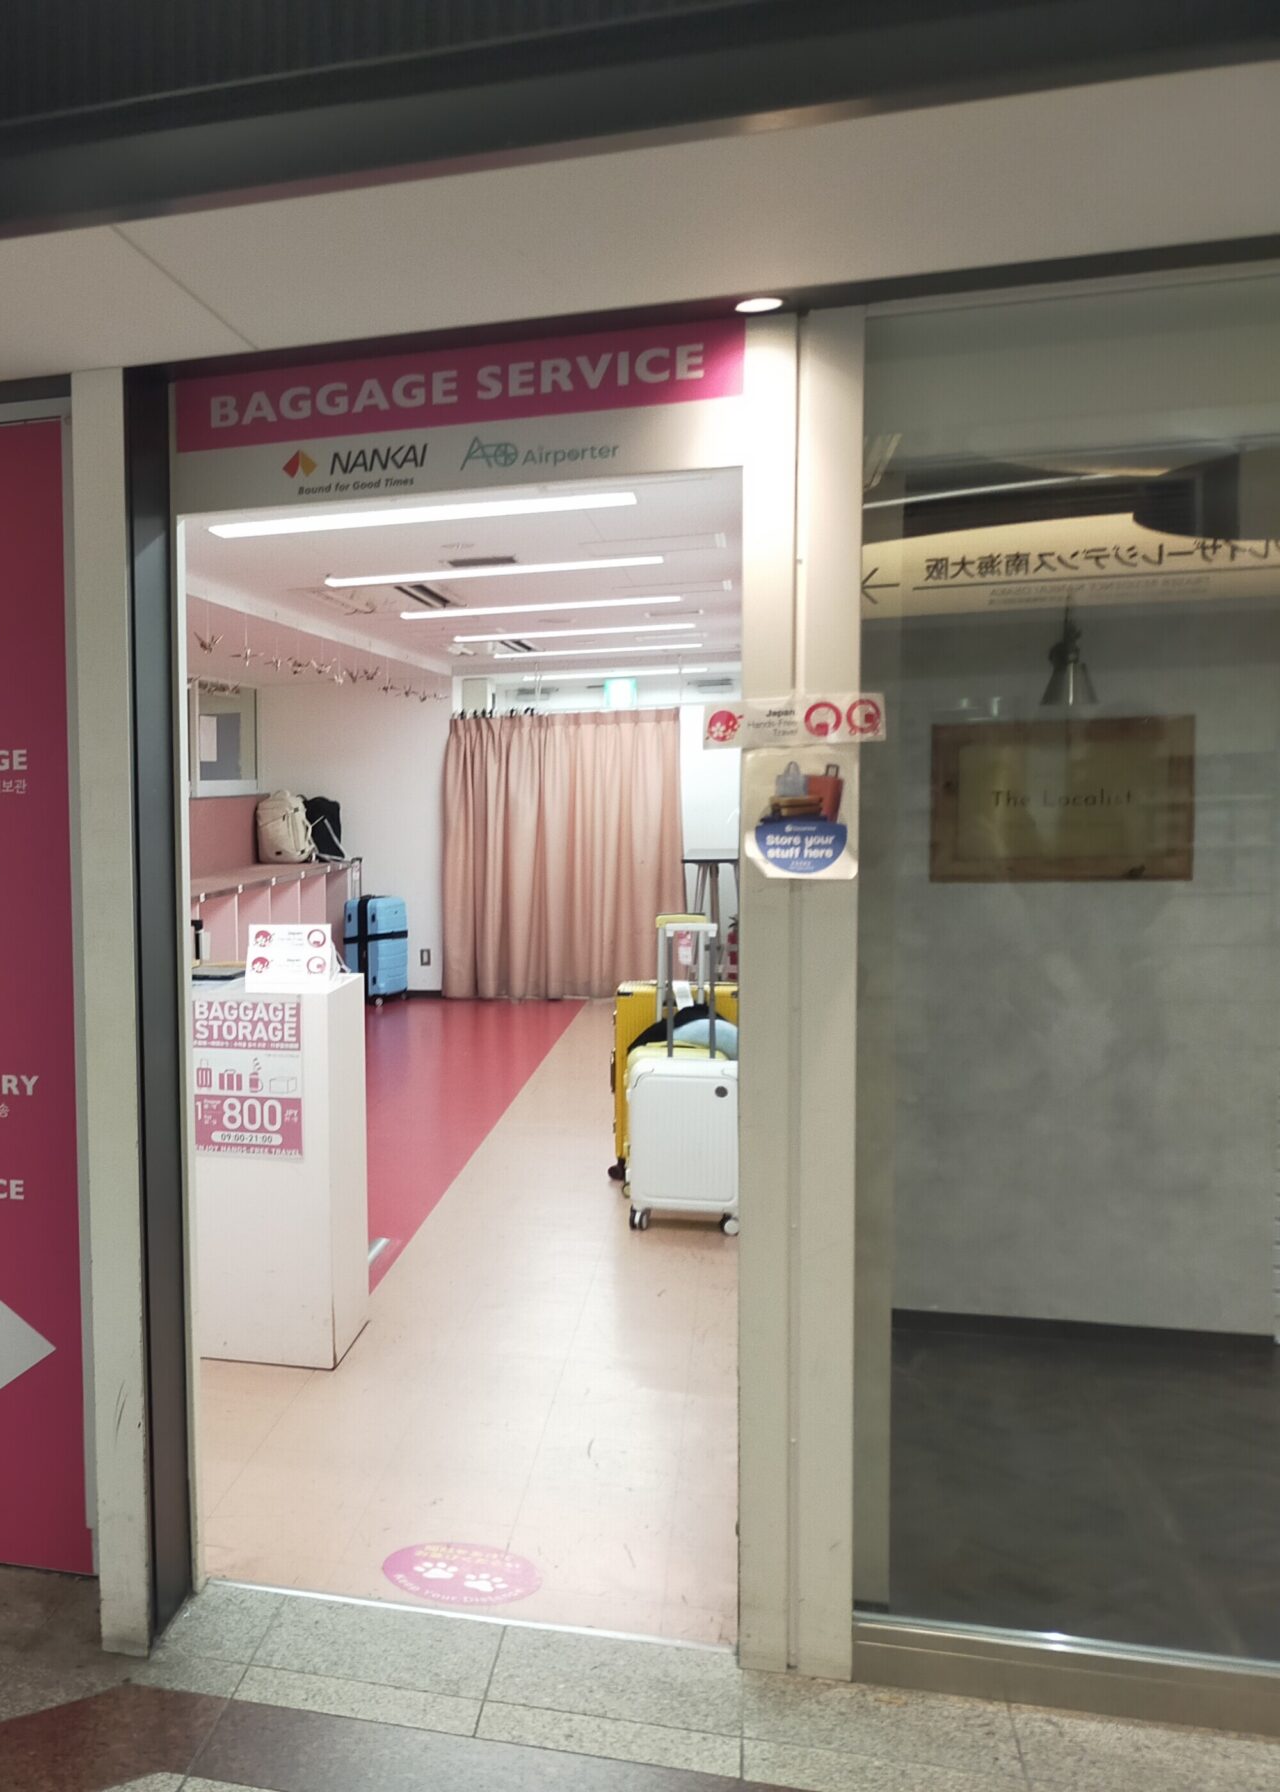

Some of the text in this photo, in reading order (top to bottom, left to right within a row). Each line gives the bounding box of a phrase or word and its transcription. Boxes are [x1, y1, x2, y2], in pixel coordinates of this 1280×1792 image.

[210, 343, 706, 429] BAGGAGE SERVICE
[329, 443, 429, 476] NANKAI
[521, 442, 620, 467] Airporter
[298, 475, 415, 495] Bound for Good Times
[765, 709, 795, 718] Japan
[766, 834, 836, 849] Store your
[767, 846, 833, 859] stuff here
[194, 1001, 297, 1022] BAGGAGE
[195, 1021, 297, 1042] STORAGE
[222, 1097, 282, 1131] 800
